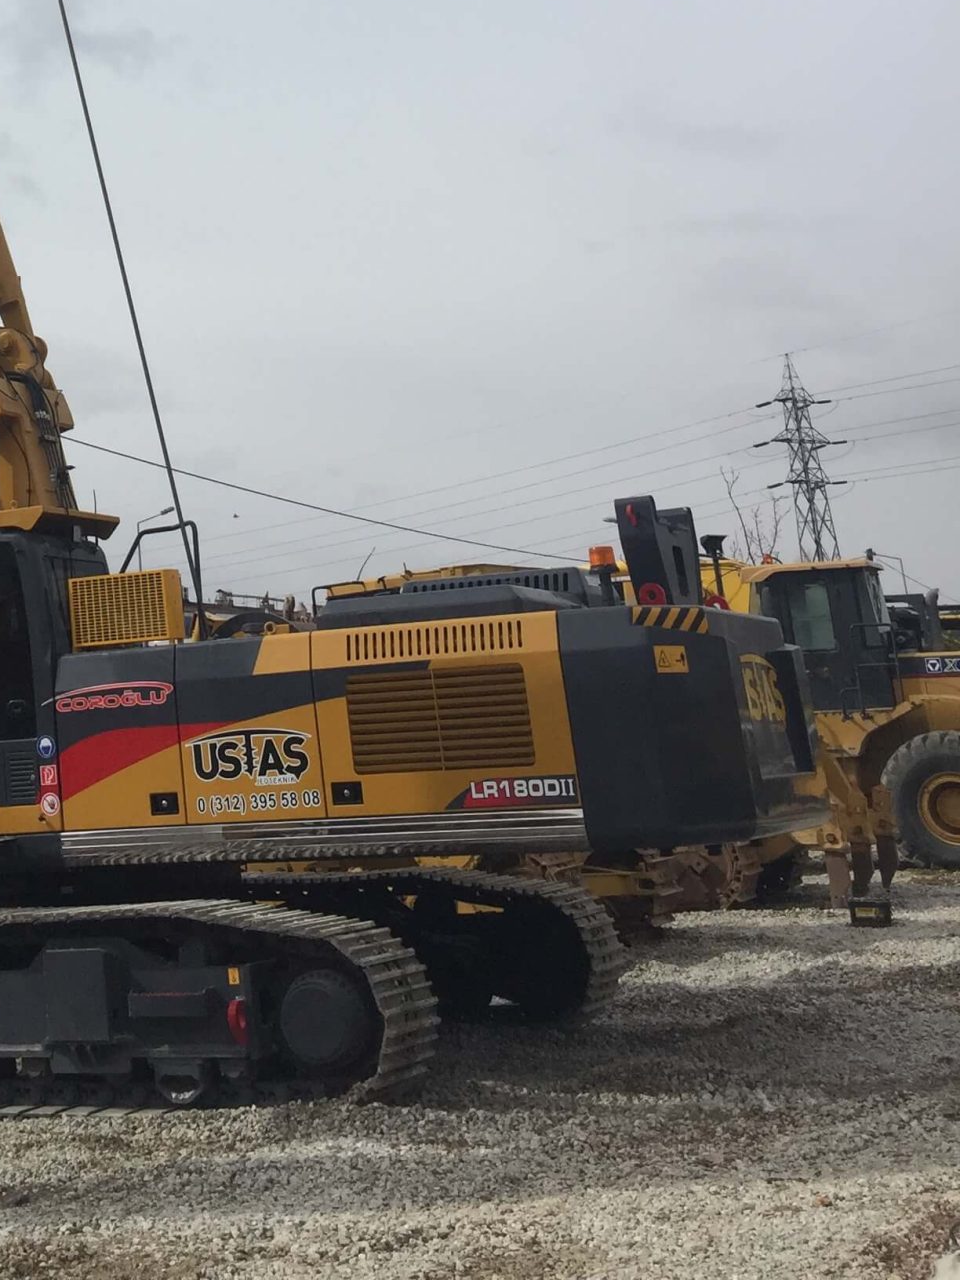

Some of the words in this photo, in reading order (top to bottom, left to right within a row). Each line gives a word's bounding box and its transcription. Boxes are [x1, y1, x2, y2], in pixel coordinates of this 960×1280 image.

[470, 778, 576, 799] LR180DII
[197, 797, 206, 814] 0
[210, 795, 246, 817] (312)
[250, 793, 277, 810] 395
[281, 792, 298, 808] 58
[303, 790, 320, 806] 08
